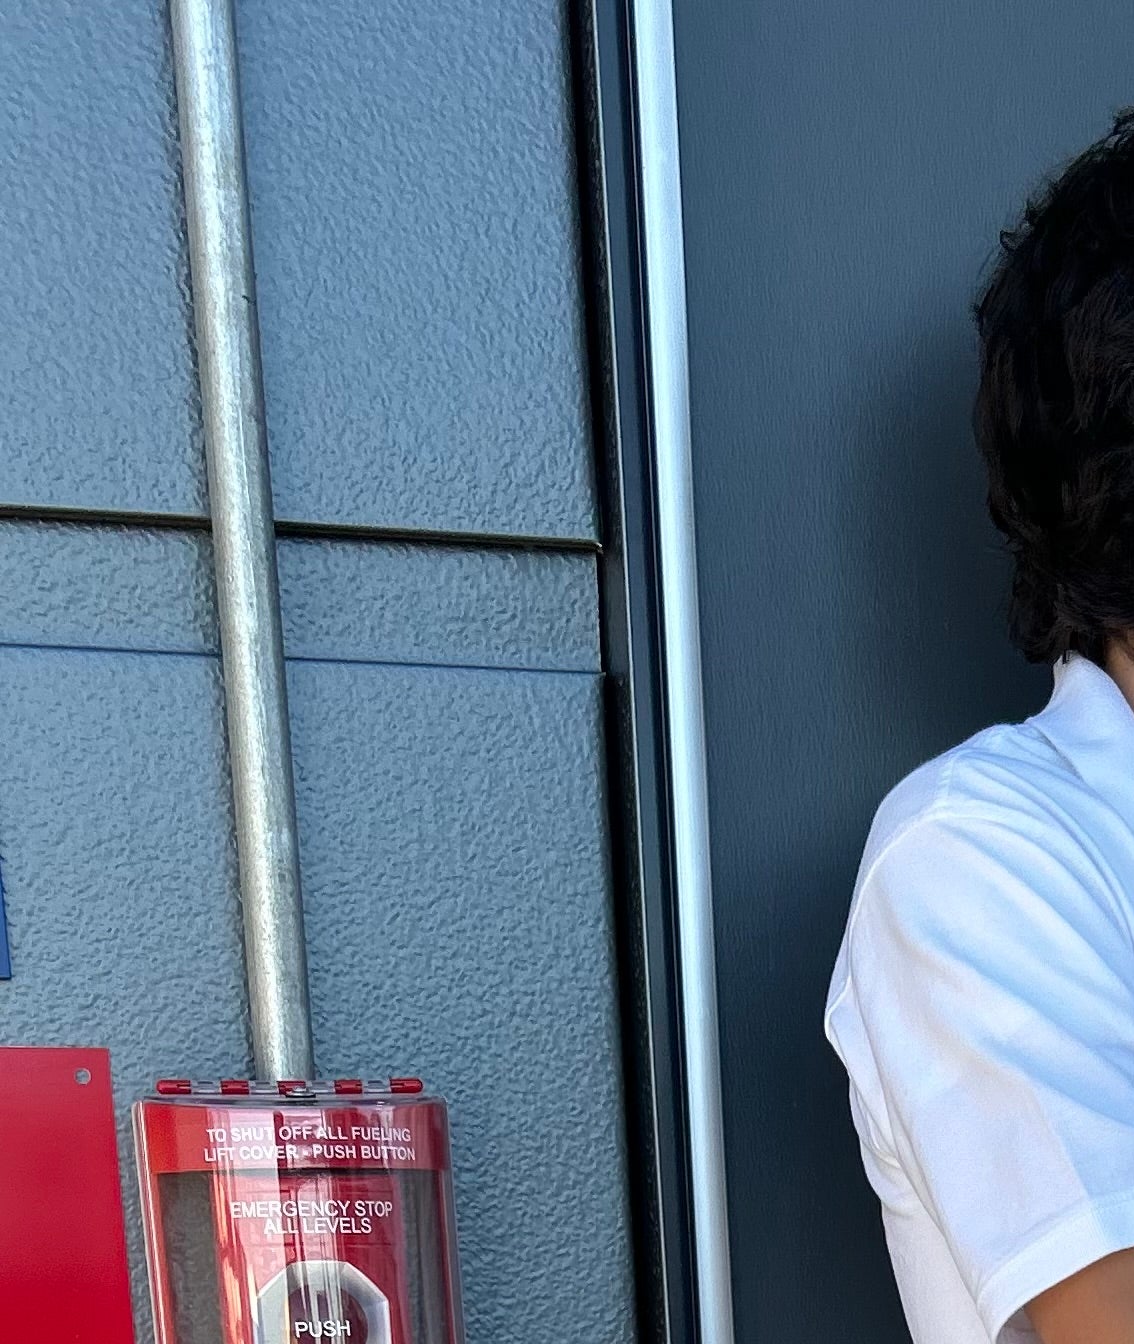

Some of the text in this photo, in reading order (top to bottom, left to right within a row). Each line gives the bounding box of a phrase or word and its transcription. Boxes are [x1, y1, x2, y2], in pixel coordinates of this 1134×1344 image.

[206, 1126, 411, 1143] TO SHUT OFF ALL FUELING
[204, 1147, 235, 1162] LIFT
[239, 1144, 298, 1160] COVER
[312, 1144, 357, 1159] PUSH
[361, 1145, 416, 1161] BUTTON
[231, 1200, 393, 1218] EMERGENCY STOP
[264, 1217, 372, 1234] ALL LEVELS
[294, 1320, 351, 1338] PUSH
